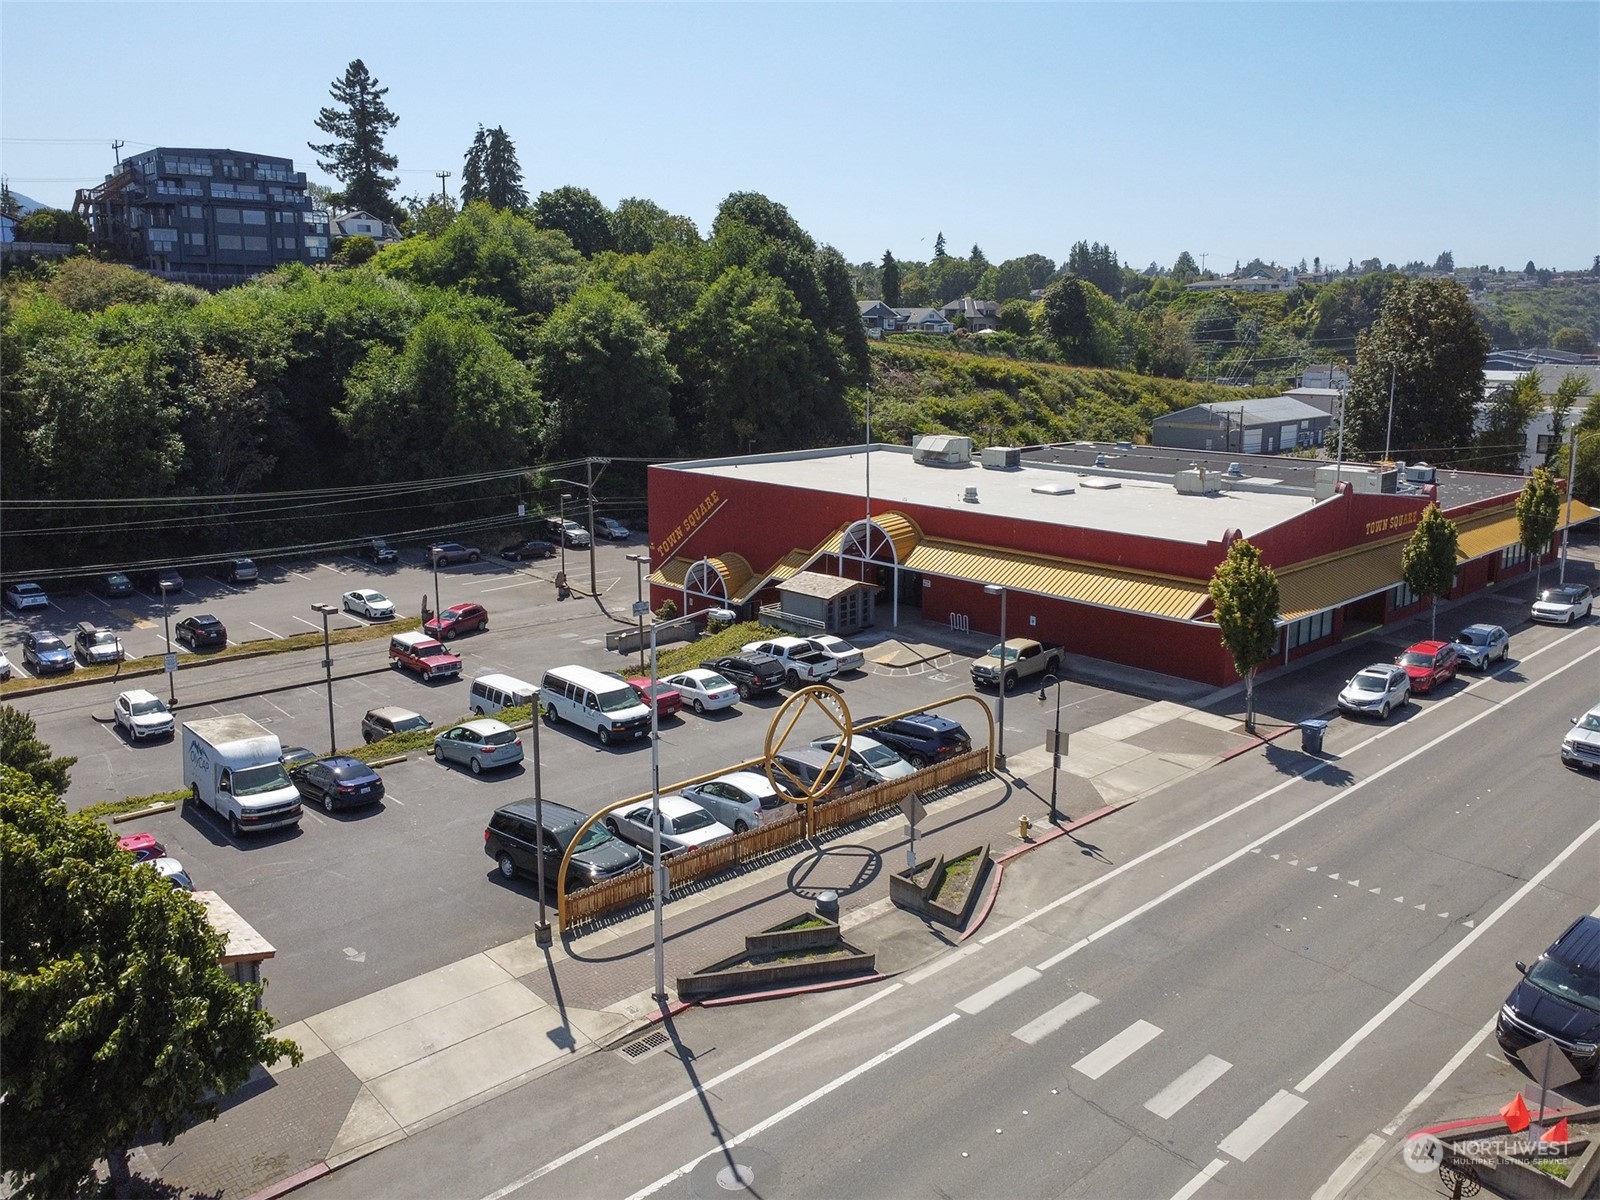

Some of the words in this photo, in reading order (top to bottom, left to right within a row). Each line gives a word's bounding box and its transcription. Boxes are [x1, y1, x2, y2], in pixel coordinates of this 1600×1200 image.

[656, 526, 684, 557] TOWN
[683, 489, 720, 532] SQUARE
[1365, 518, 1389, 535] TOWN
[1389, 511, 1418, 530] SQUARE
